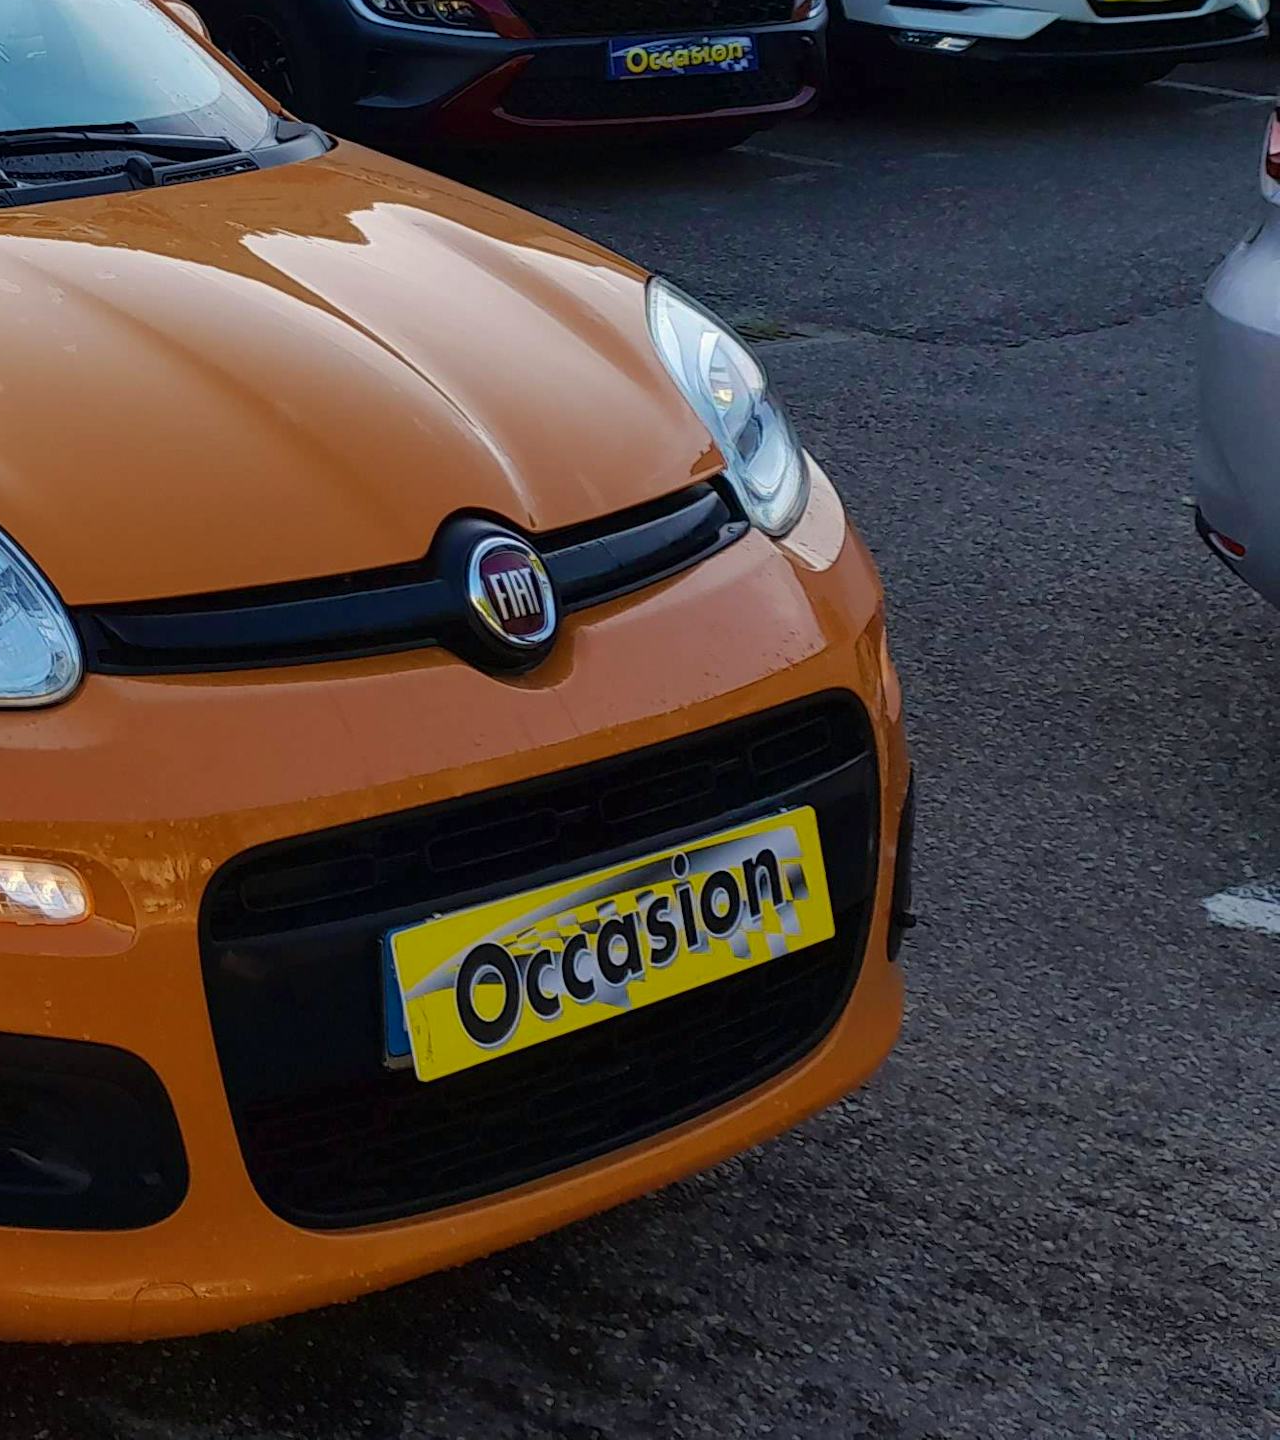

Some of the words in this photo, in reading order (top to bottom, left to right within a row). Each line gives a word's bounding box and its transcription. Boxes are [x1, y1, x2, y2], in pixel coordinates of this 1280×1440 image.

[626, 36, 744, 74] Occasion
[487, 567, 541, 621] FIAT
[454, 848, 788, 1049] Occasion
